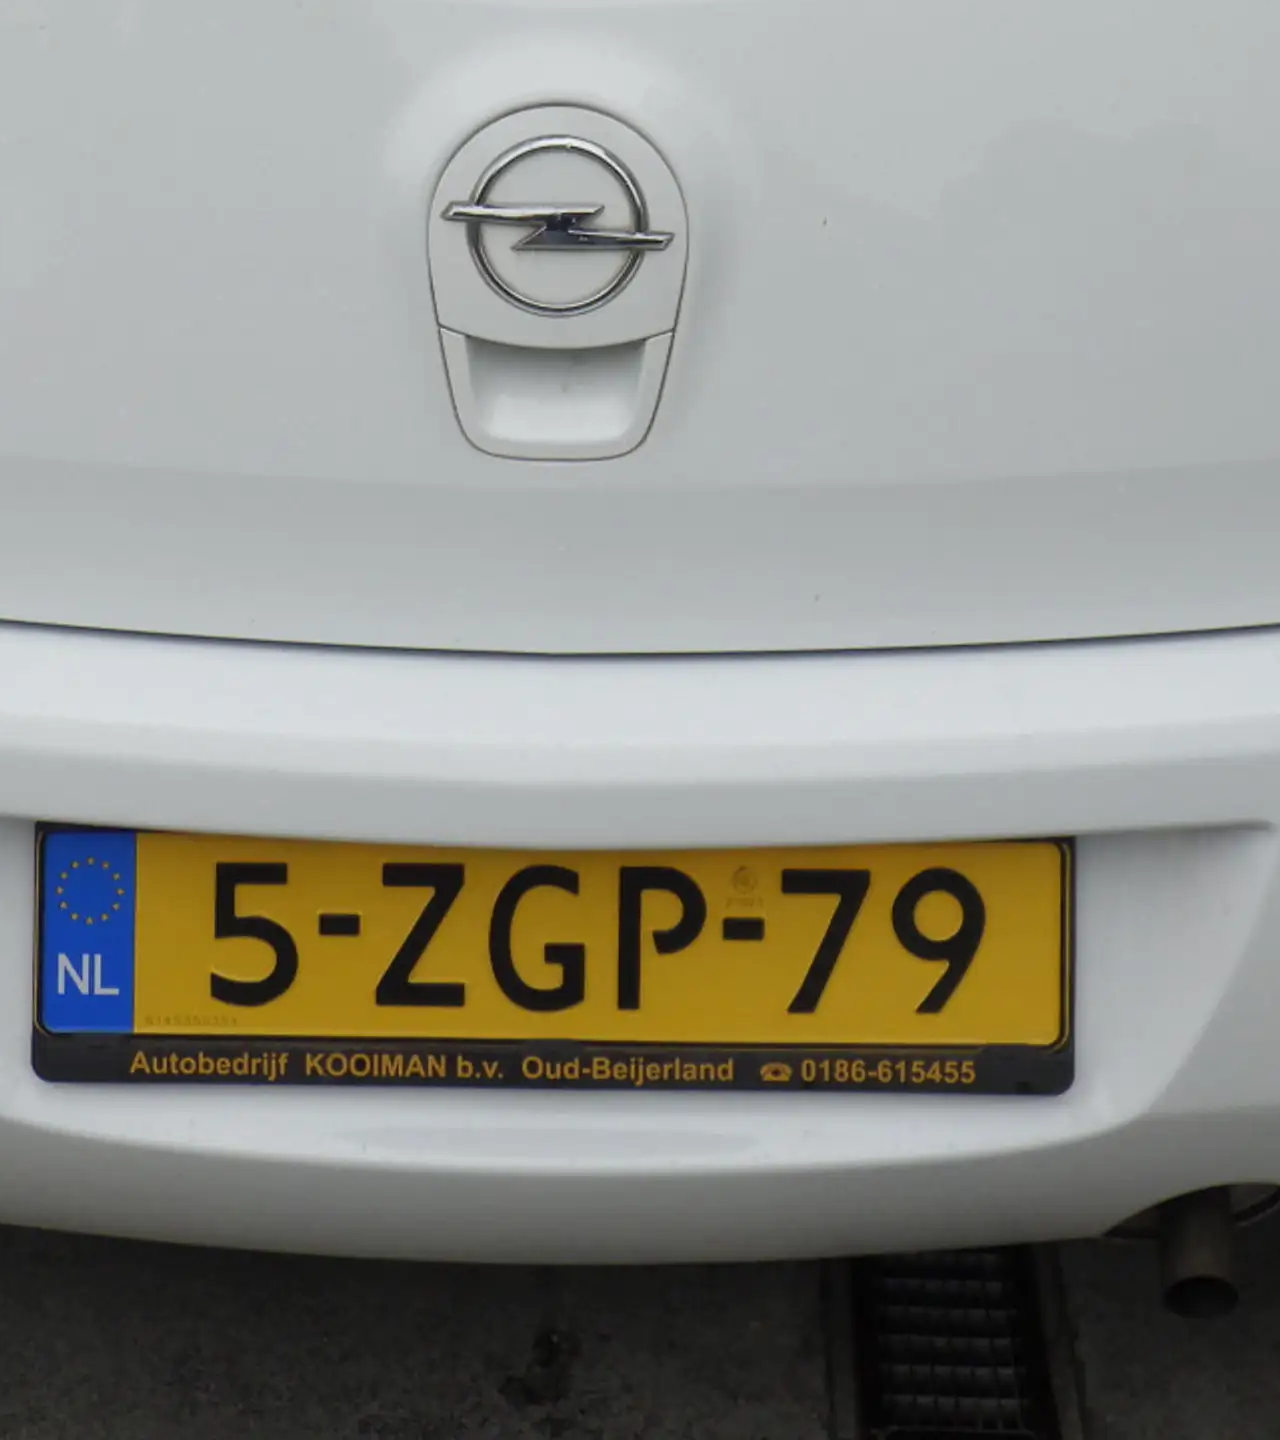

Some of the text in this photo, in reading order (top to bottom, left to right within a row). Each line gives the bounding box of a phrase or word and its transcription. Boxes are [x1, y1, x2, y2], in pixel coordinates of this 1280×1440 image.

[56, 860, 987, 1015] NL 5-ZGP-79
[129, 1051, 977, 1087] Autobedrijf KOOIMAN b.v. Oud-Beijerland 0186-615455
